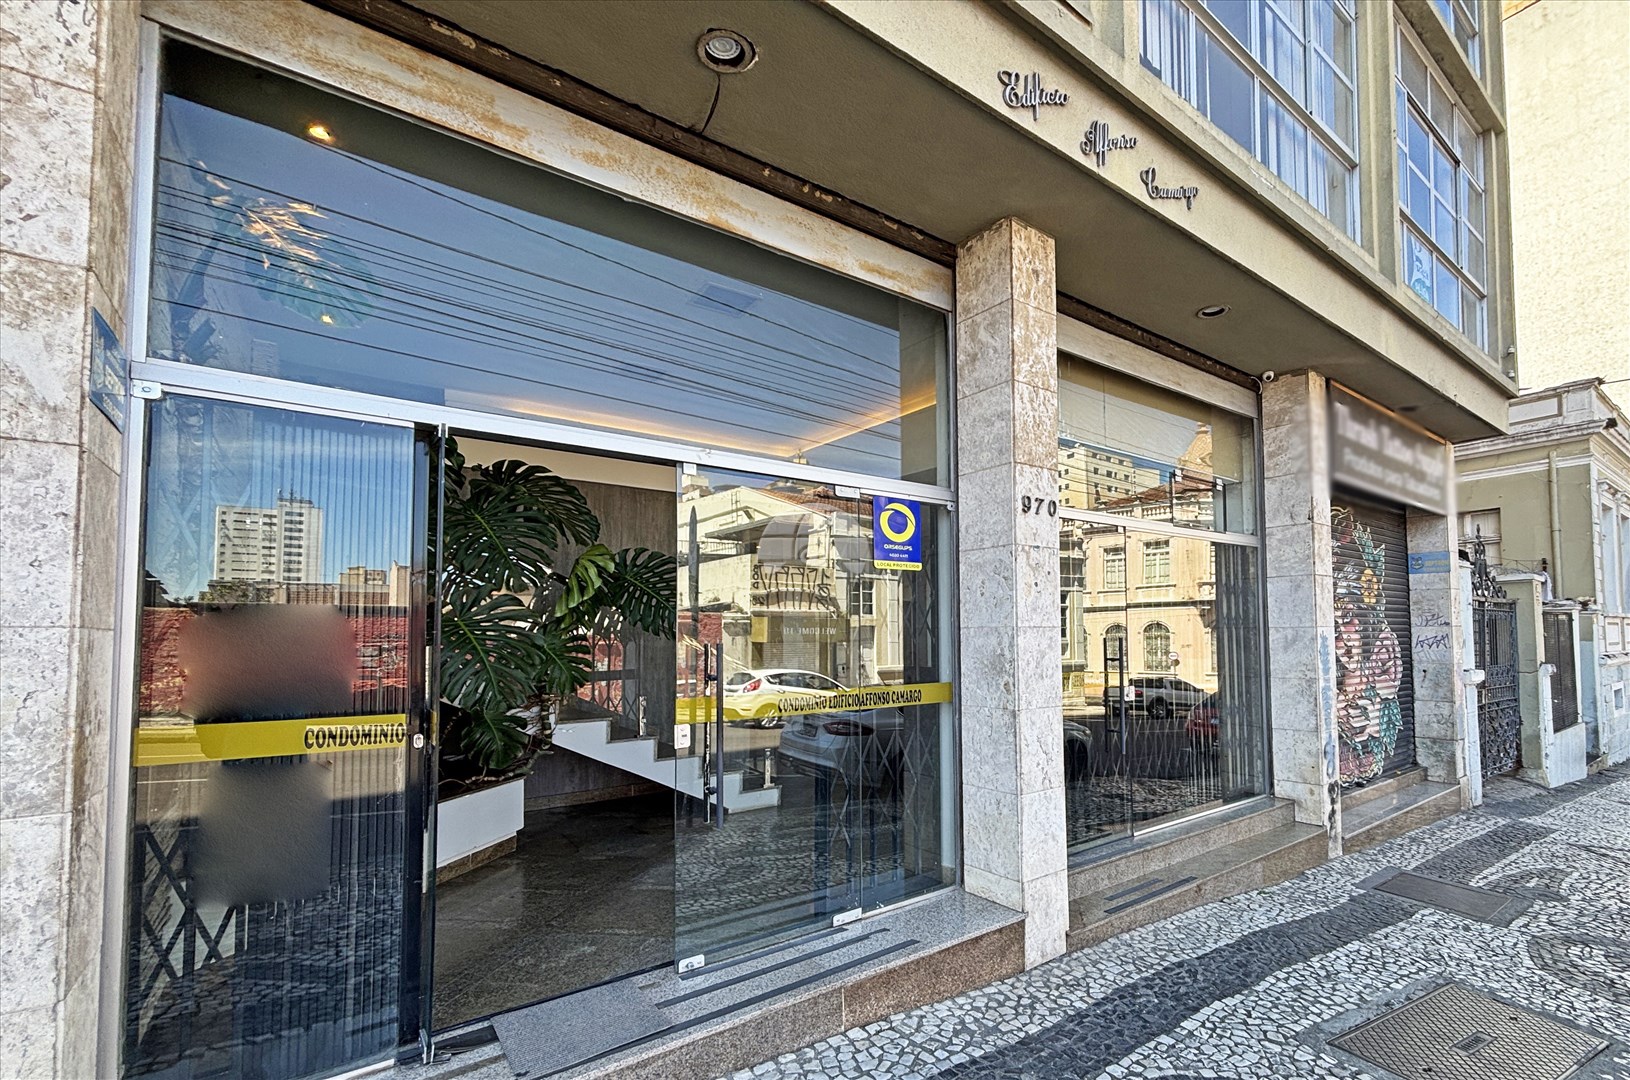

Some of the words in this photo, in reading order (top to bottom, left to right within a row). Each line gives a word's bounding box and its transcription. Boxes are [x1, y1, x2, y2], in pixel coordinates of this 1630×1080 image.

[997, 70, 1070, 121] Edificio
[1080, 120, 1139, 167] Affonso
[1140, 167, 1199, 210] Camargo
[1021, 495, 1057, 517] 970
[778, 694, 827, 713] CONDOMINIO
[828, 693, 860, 709] EDIFICIO
[860, 690, 890, 706] AFFONSO
[891, 689, 922, 704] CAMARGO
[304, 722, 406, 749] CONDOMINIO
